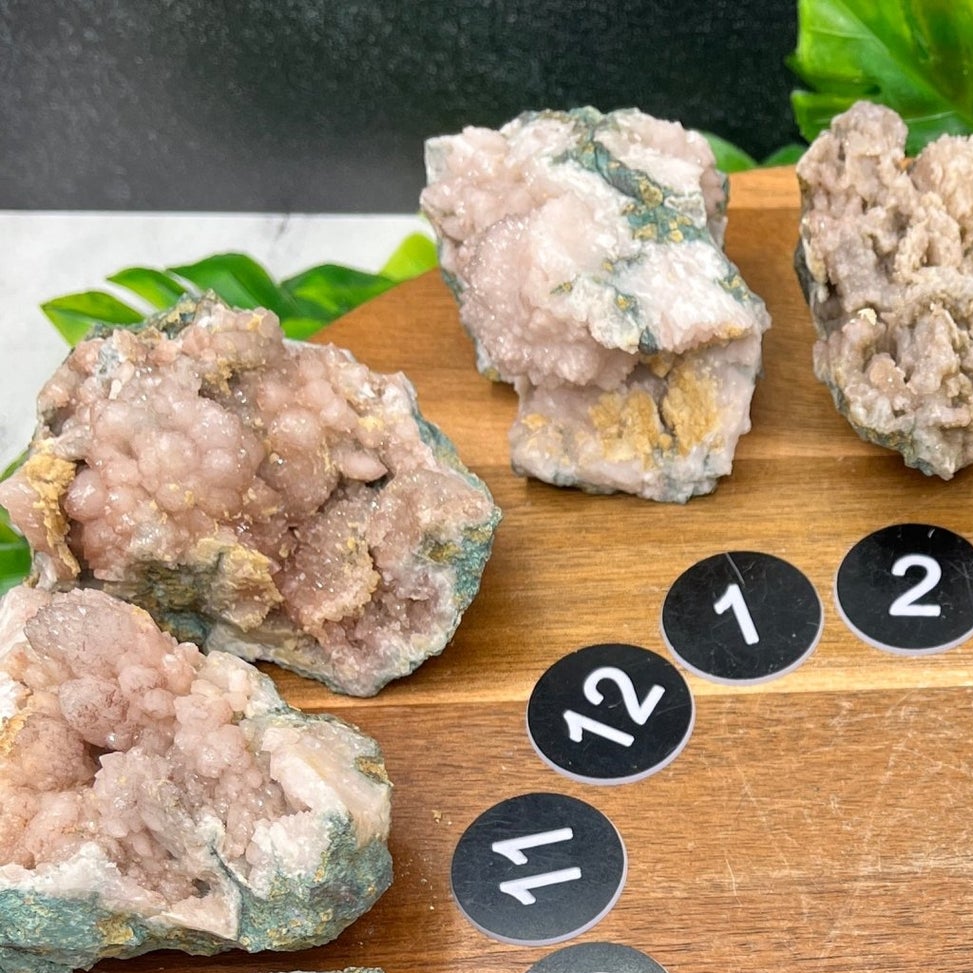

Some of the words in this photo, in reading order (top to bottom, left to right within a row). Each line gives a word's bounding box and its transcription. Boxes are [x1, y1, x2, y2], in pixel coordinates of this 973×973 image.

[714, 584, 759, 644] 1
[890, 556, 941, 616] 2
[563, 667, 666, 746] 12
[491, 827, 581, 905] 11
